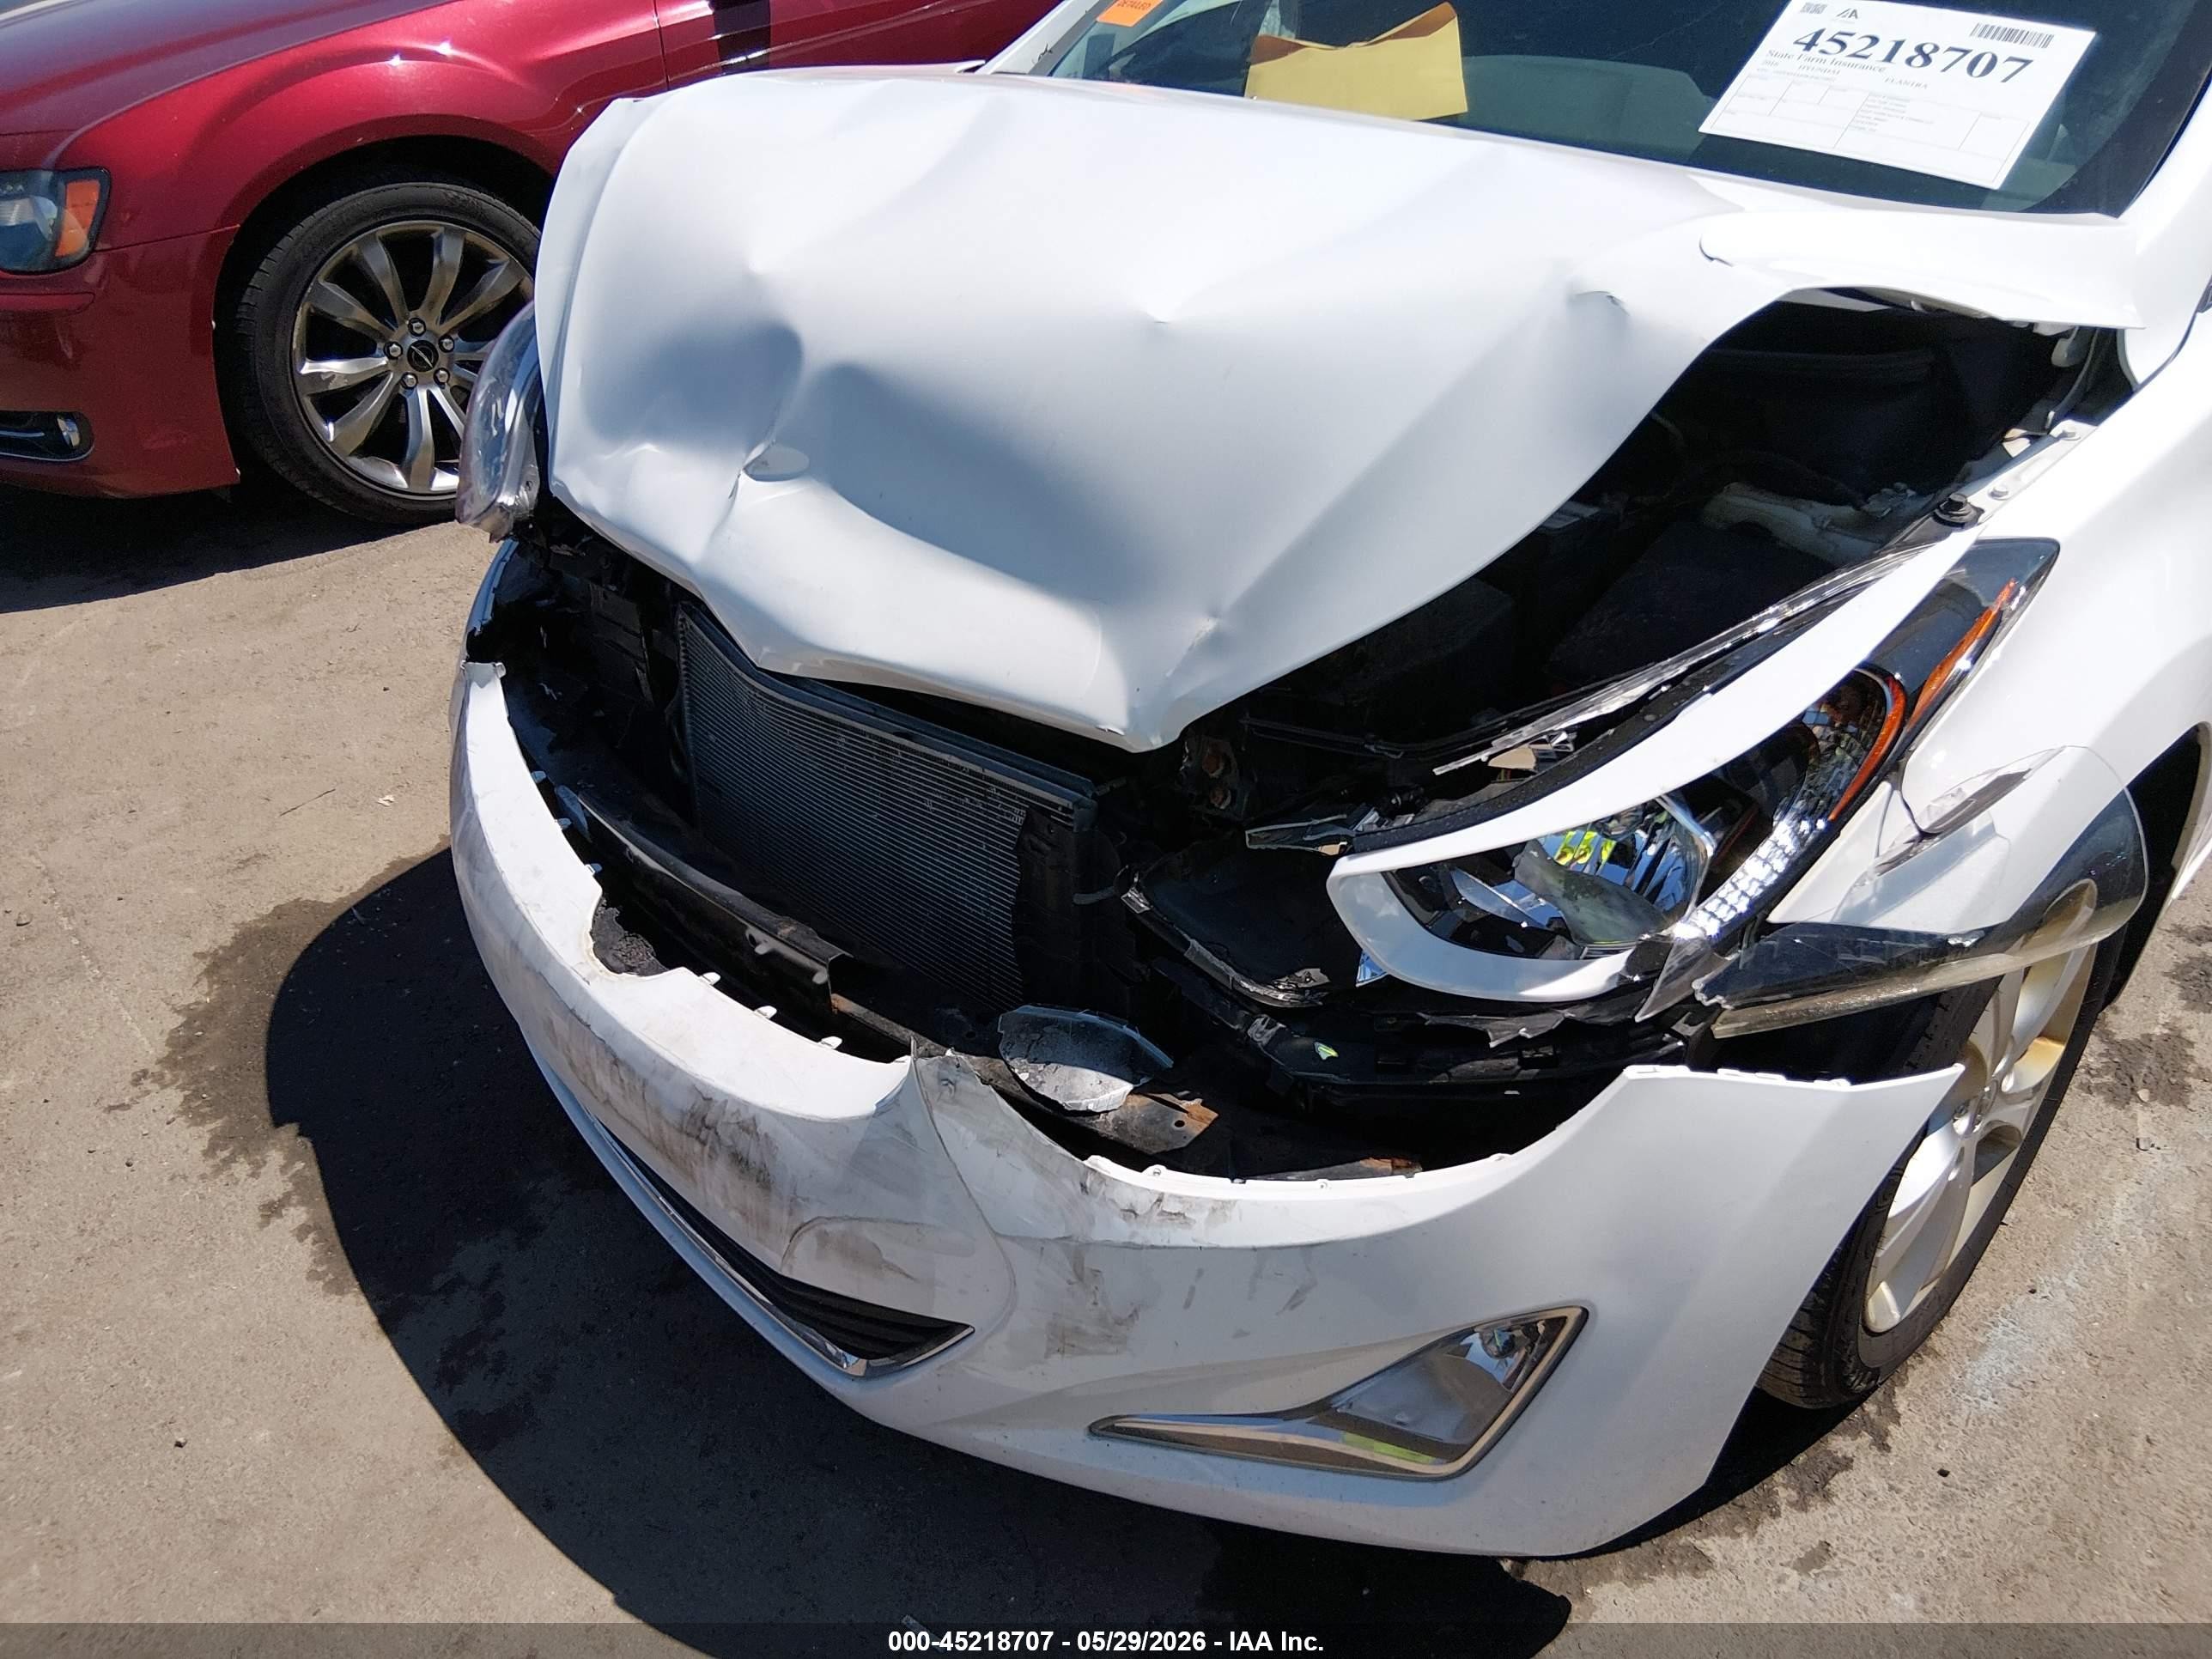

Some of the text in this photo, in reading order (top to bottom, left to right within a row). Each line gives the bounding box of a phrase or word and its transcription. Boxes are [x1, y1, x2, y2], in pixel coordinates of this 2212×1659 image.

[1766, 49, 1886, 73] State Farm Insurance
[1793, 27, 2033, 83] 45218707
[1884, 76, 1928, 89] ELANTRA
